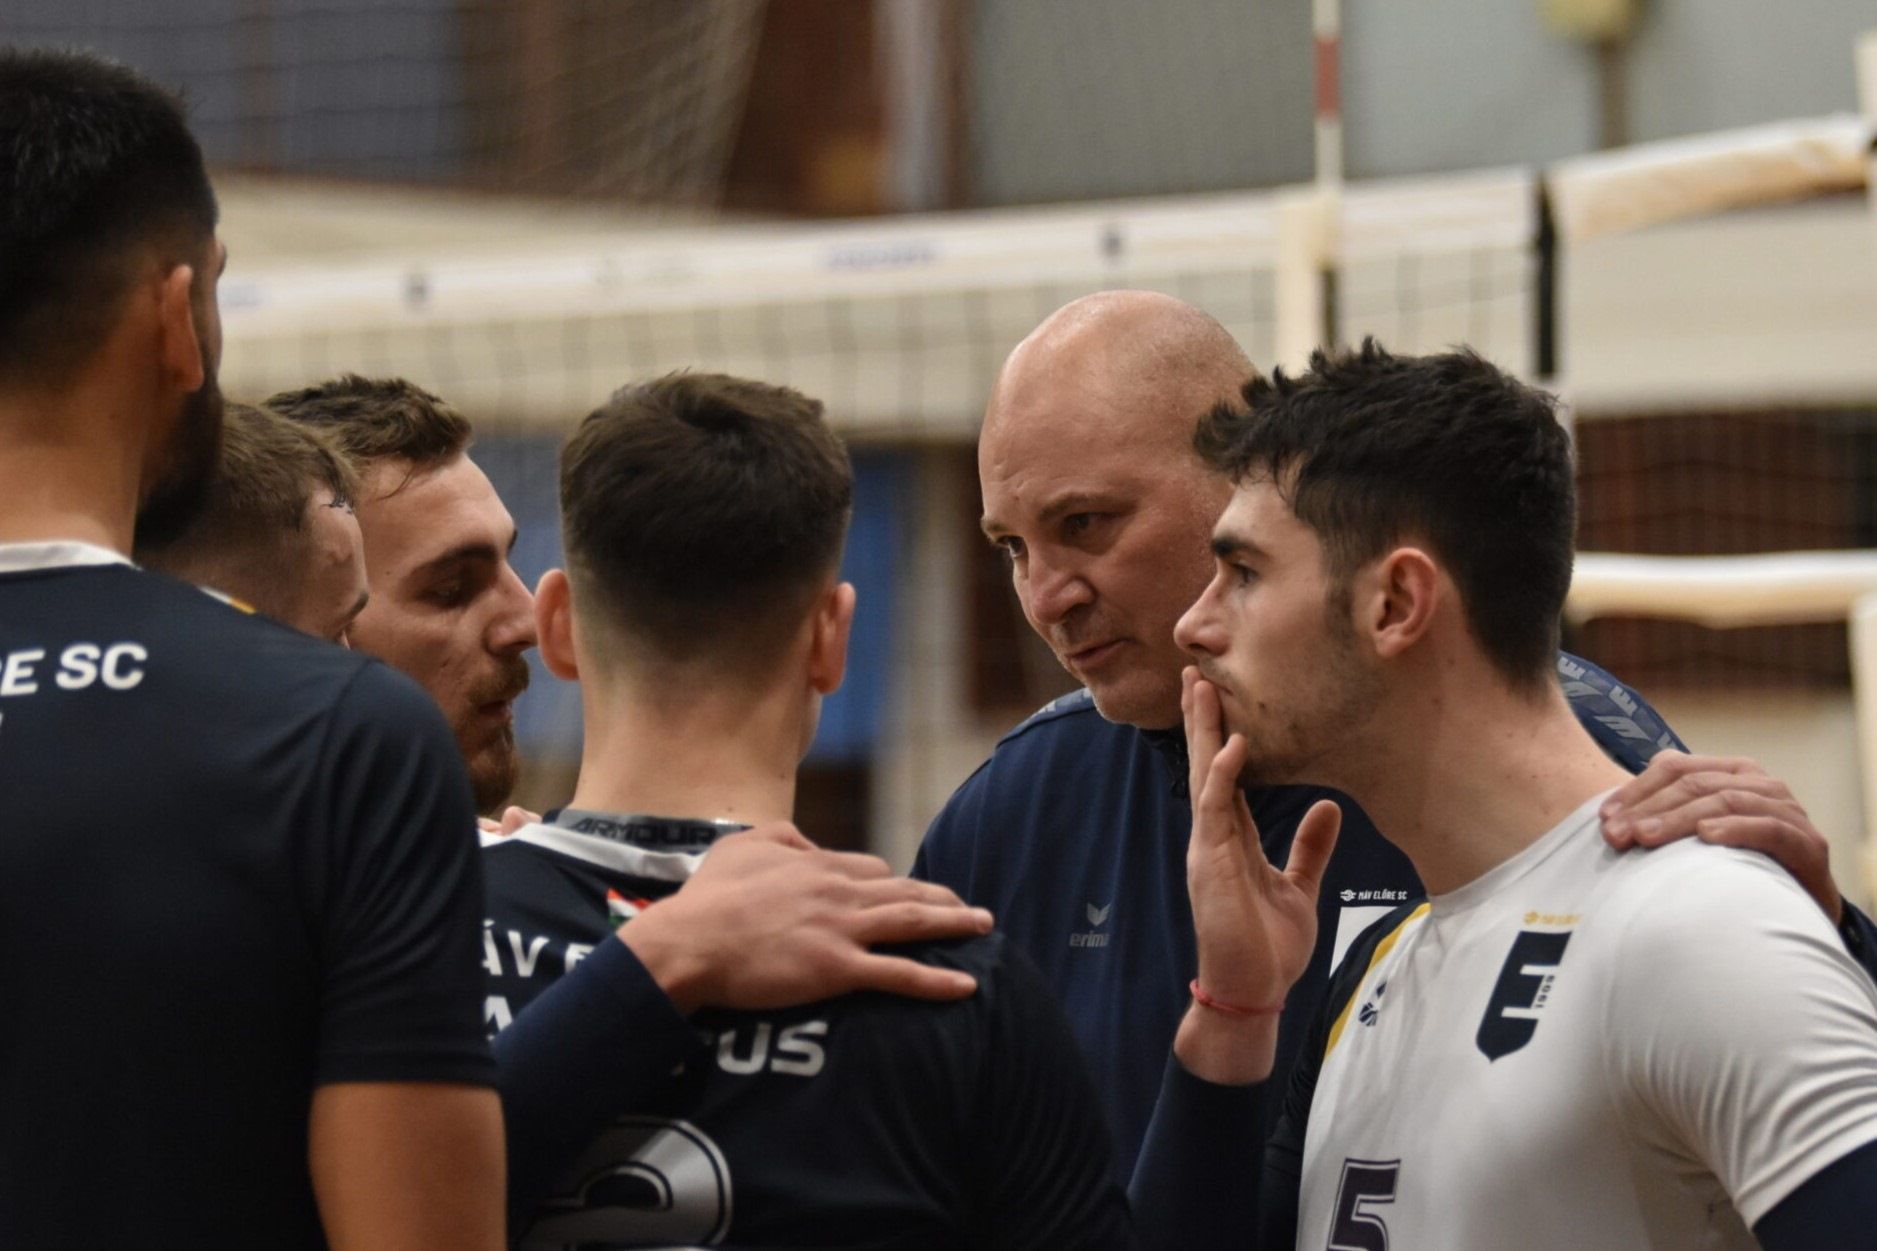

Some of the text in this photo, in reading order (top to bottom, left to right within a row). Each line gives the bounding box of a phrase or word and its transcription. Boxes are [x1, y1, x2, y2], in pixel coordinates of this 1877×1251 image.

[0, 641, 148, 697] E SC
[1398, 890, 1408, 900] SC
[1327, 1157, 1402, 1251] 5
